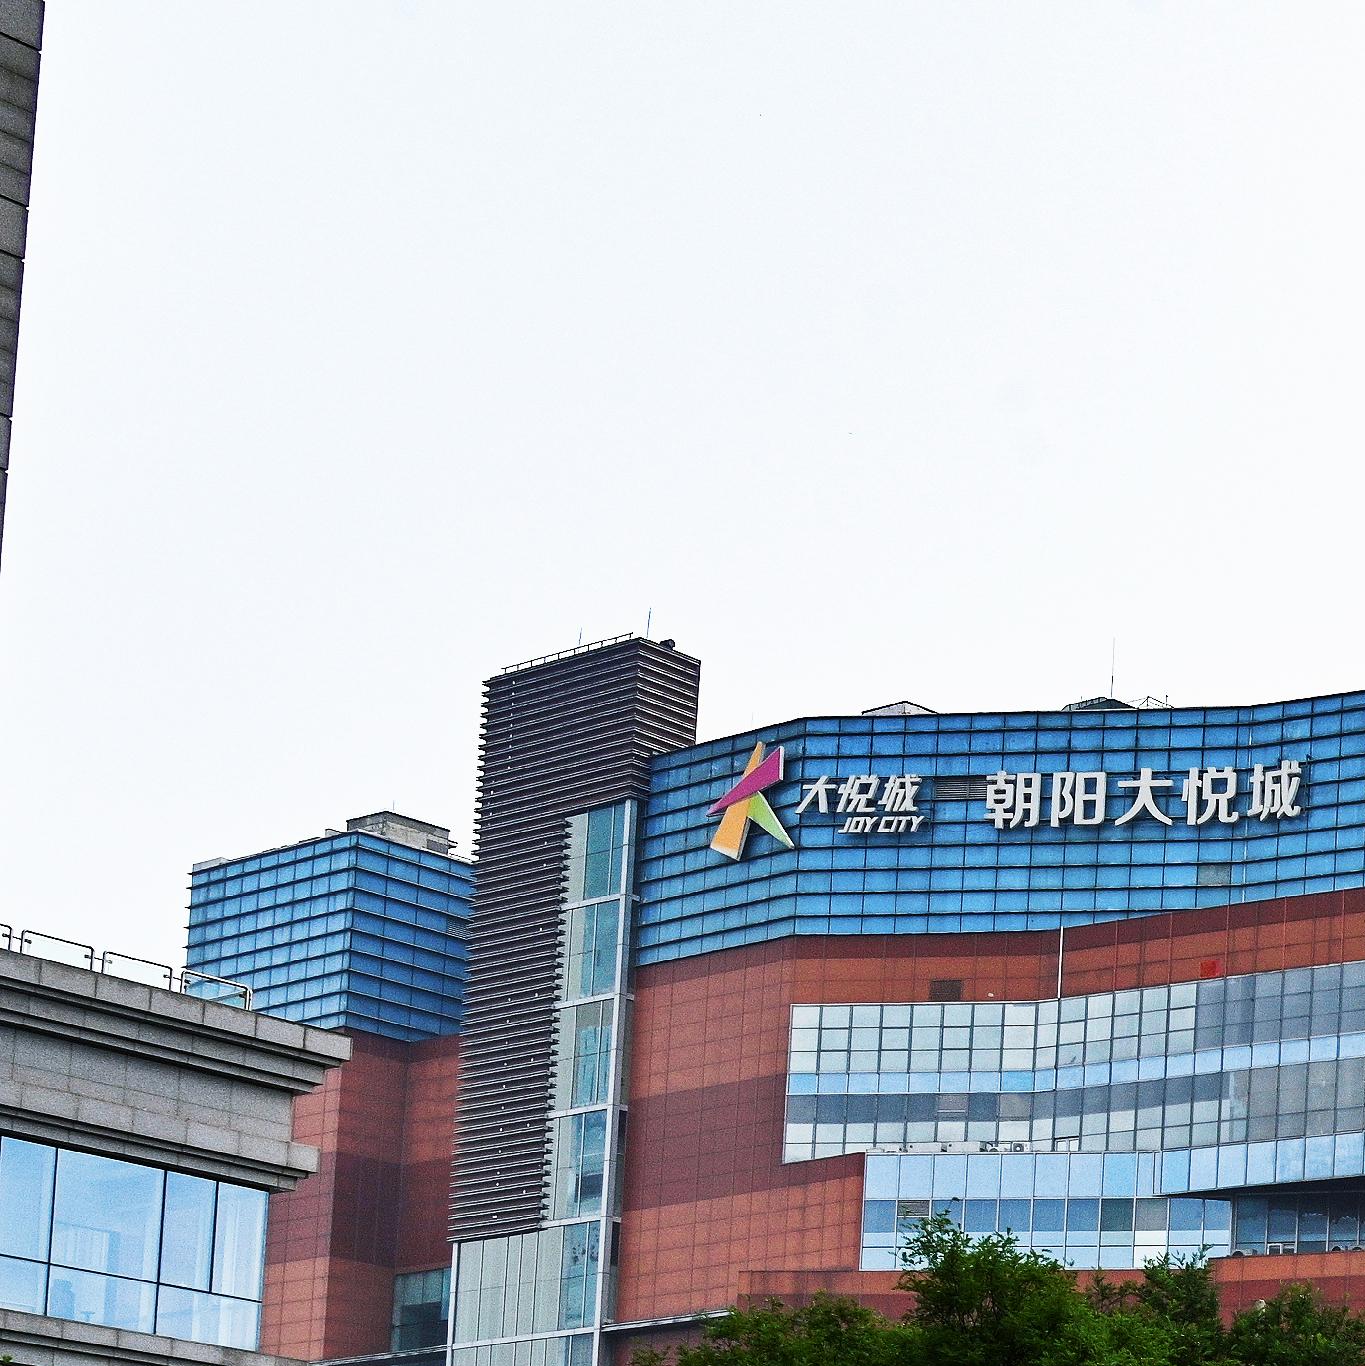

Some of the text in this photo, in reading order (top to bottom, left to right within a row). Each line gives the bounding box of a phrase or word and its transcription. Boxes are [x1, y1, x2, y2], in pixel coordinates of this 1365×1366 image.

[795, 774, 922, 814] 大悦城
[984, 760, 1302, 829] 朝阳大悦城
[838, 815, 925, 834] JOY CITY
